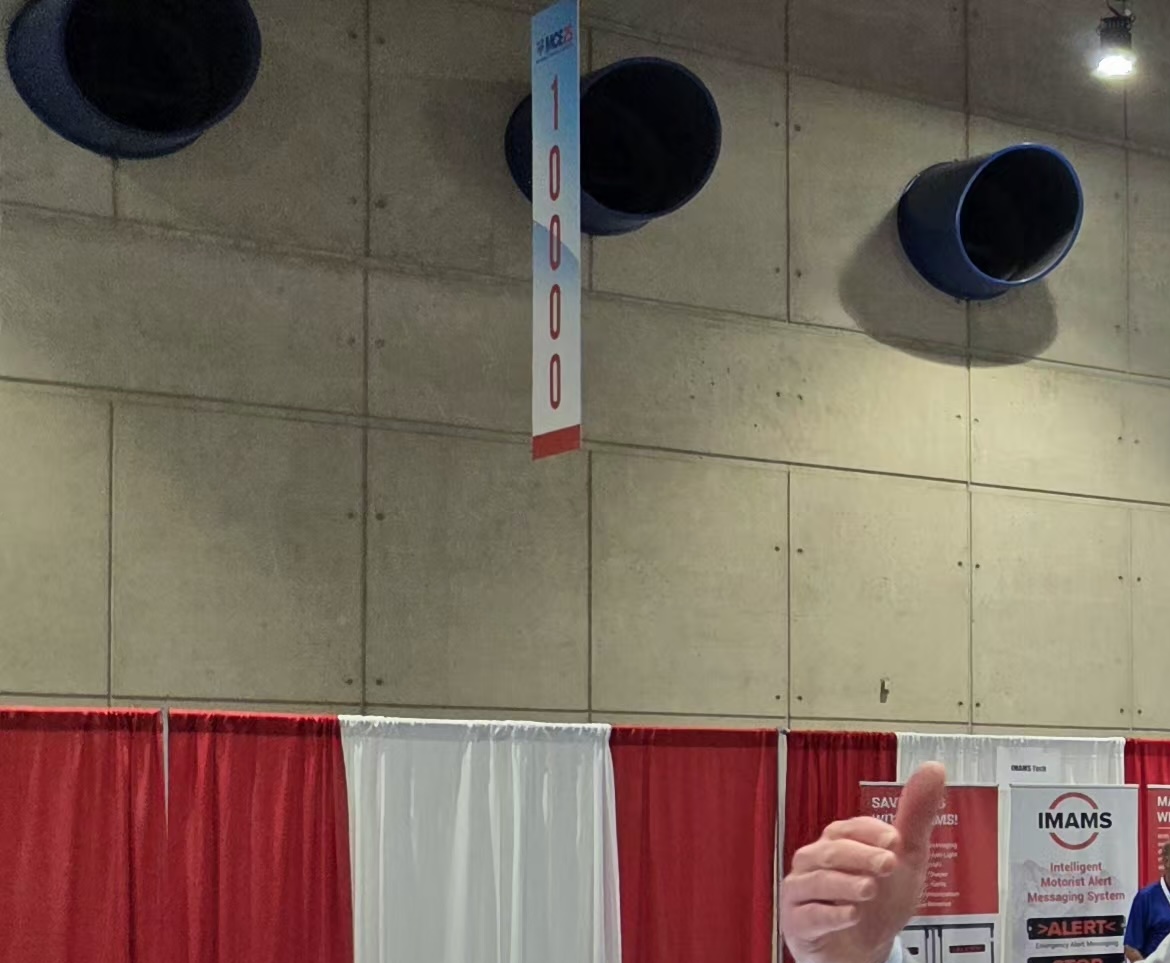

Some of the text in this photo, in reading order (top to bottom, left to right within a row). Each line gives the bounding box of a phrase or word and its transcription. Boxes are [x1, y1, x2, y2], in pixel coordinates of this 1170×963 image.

[871, 796, 899, 809] SAV
[1038, 812, 1113, 829] IMAMS
[1050, 861, 1103, 874] Intelligent
[1040, 875, 1112, 888] Motorist Alert
[1027, 890, 1126, 905] Messaging System
